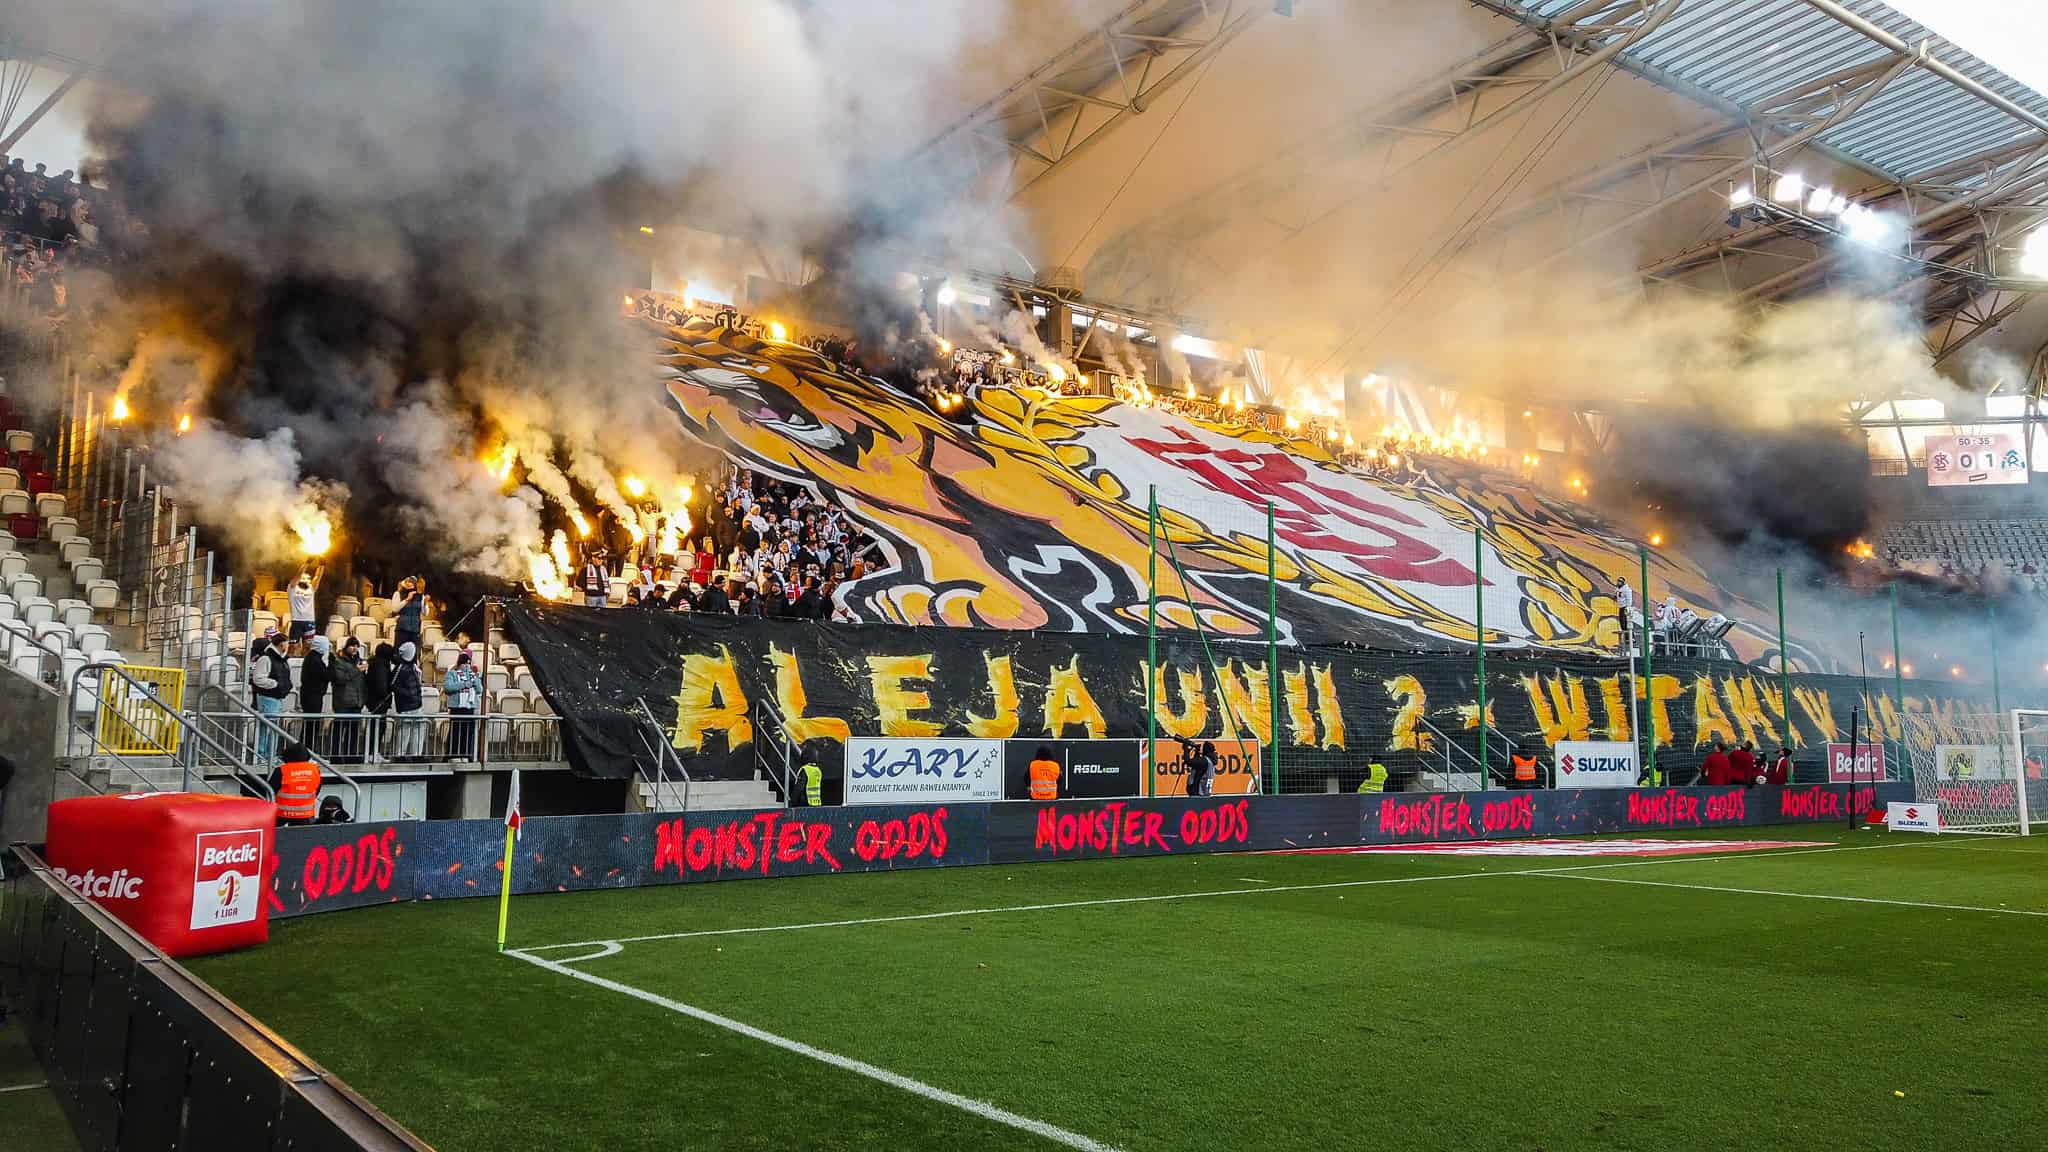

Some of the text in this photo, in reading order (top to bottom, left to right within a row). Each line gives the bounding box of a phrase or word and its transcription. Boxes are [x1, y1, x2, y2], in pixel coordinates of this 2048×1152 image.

[671, 641, 1107, 753] ALEJA
[1139, 658, 1346, 751] UNII
[1521, 667, 1807, 750] WITAMY
[851, 747, 979, 779] KARY
[1578, 757, 1631, 772] SUZUKI
[1379, 792, 1533, 839] MONSTER ODDS
[1627, 788, 1745, 826] MONSTER ODDS
[1781, 785, 1841, 820] MONSTER
[655, 806, 948, 878] MONSTER ODDS
[1035, 799, 1249, 856] MONSTER ODDS
[203, 843, 257, 866] Betclic
[303, 826, 397, 900] ODDS
[221, 907, 238, 919] LIGA
